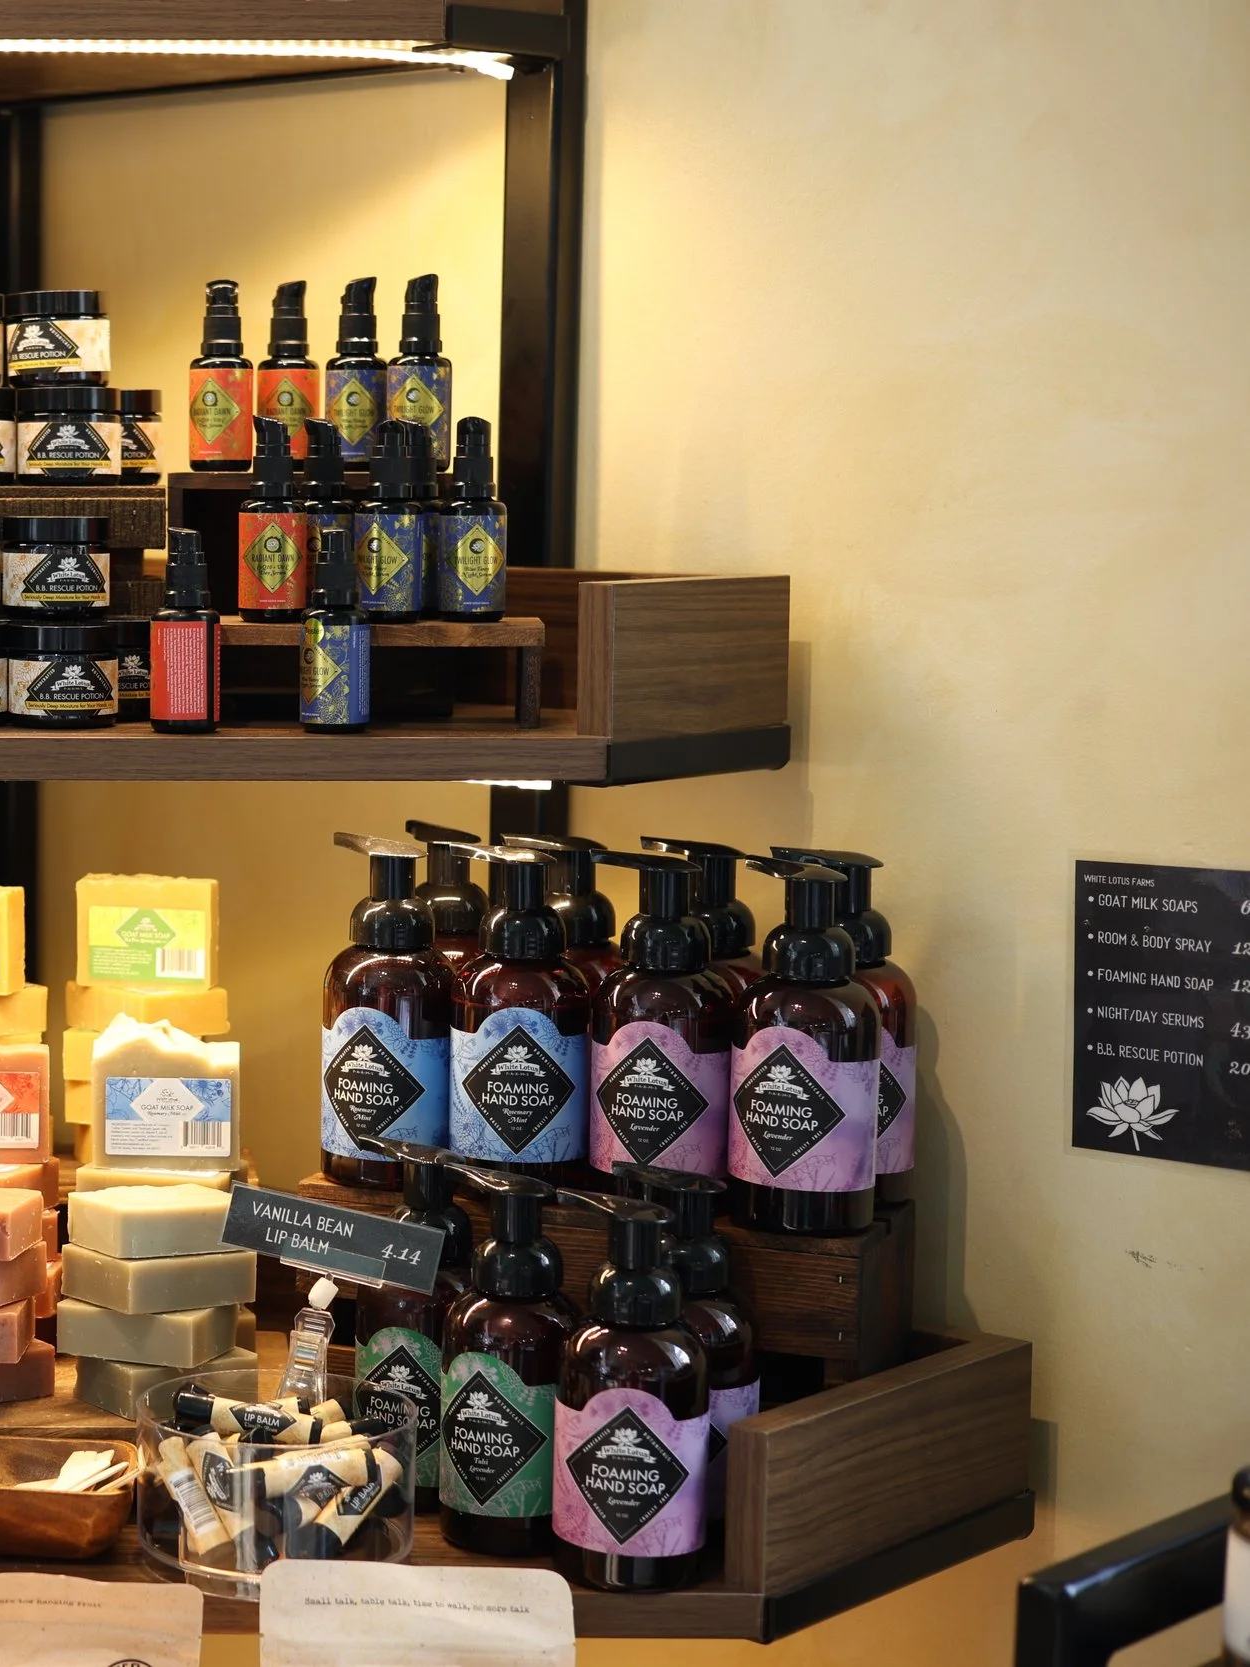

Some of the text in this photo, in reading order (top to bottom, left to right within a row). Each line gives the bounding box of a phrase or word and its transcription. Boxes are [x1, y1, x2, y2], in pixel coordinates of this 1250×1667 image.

[251, 553, 295, 562] RADIANT DAWN
[454, 556, 498, 565] TWILIGHT GLOW
[49, 584, 75, 592] RESCUE
[76, 584, 98, 592] POTION
[53, 693, 80, 701] RESCUE
[80, 692, 105, 700] POTION
[1083, 874, 1155, 888] WHITE LOTUS FARMS
[1098, 893, 1199, 914] GOAT MILK SOAPS
[1097, 930, 1212, 954] ROOM & BODY SPRAY
[1097, 968, 1214, 992] FOAMING HAND SOAP
[1097, 1005, 1205, 1029] NIGHT/DAY SERUMS
[1097, 1042, 1204, 1068] B.B. RESCUE POTION
[338, 1077, 394, 1094] FOAMING
[487, 1081, 549, 1094] FOAMING
[334, 1088, 400, 1107] HAND SOAP
[481, 1092, 555, 1107] HAND SOAP
[616, 1092, 678, 1109] FOAMING
[349, 1104, 377, 1115] Rosemary
[353, 1113, 372, 1121] Mint
[502, 1108, 533, 1117] Rosemary
[611, 1103, 684, 1122] HAND SOAP
[750, 1099, 813, 1119] FOAMING
[507, 1116, 528, 1124] Mint
[629, 1122, 660, 1133] Lavender
[745, 1111, 819, 1132] HAND SOAP
[762, 1130, 794, 1141] Lavender
[251, 1200, 355, 1239] VANILLA BEAN
[264, 1227, 330, 1256] LIP BALM
[380, 1243, 423, 1266] 4.14
[243, 1413, 281, 1428] LIP BALM
[454, 1425, 513, 1445] FOAMING
[450, 1438, 520, 1458] HAND SOAP
[591, 1463, 660, 1482] FOAMING
[585, 1475, 666, 1495] HAND SOAP
